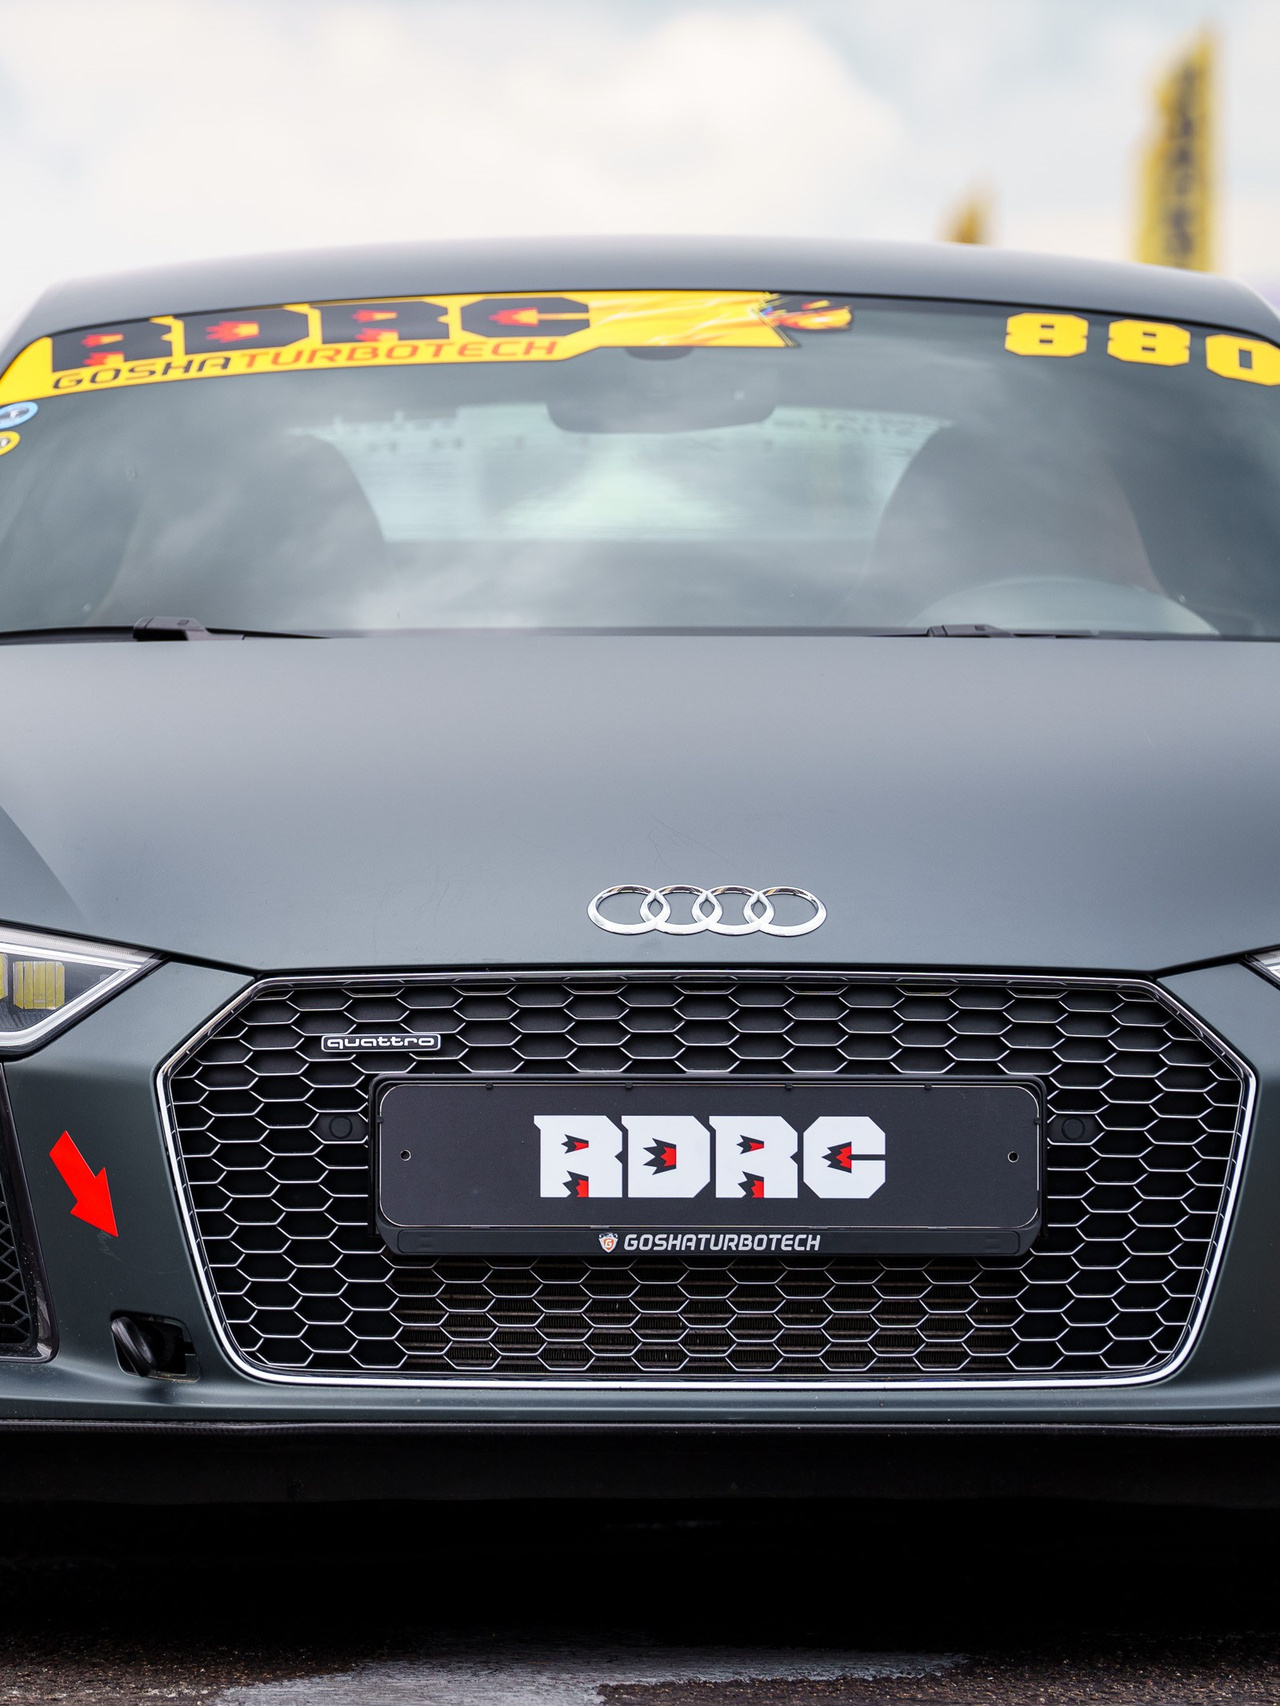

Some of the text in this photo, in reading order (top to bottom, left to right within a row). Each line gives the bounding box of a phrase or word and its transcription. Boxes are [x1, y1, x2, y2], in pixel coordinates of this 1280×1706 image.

[52, 296, 590, 373] RDRC
[53, 341, 559, 390] GOSHATURBOTECH
[1004, 312, 1280, 387] 880
[326, 1036, 435, 1050] quattro
[533, 1115, 886, 1199] RDRC
[623, 1233, 821, 1251] GOSHATURBOTECH
